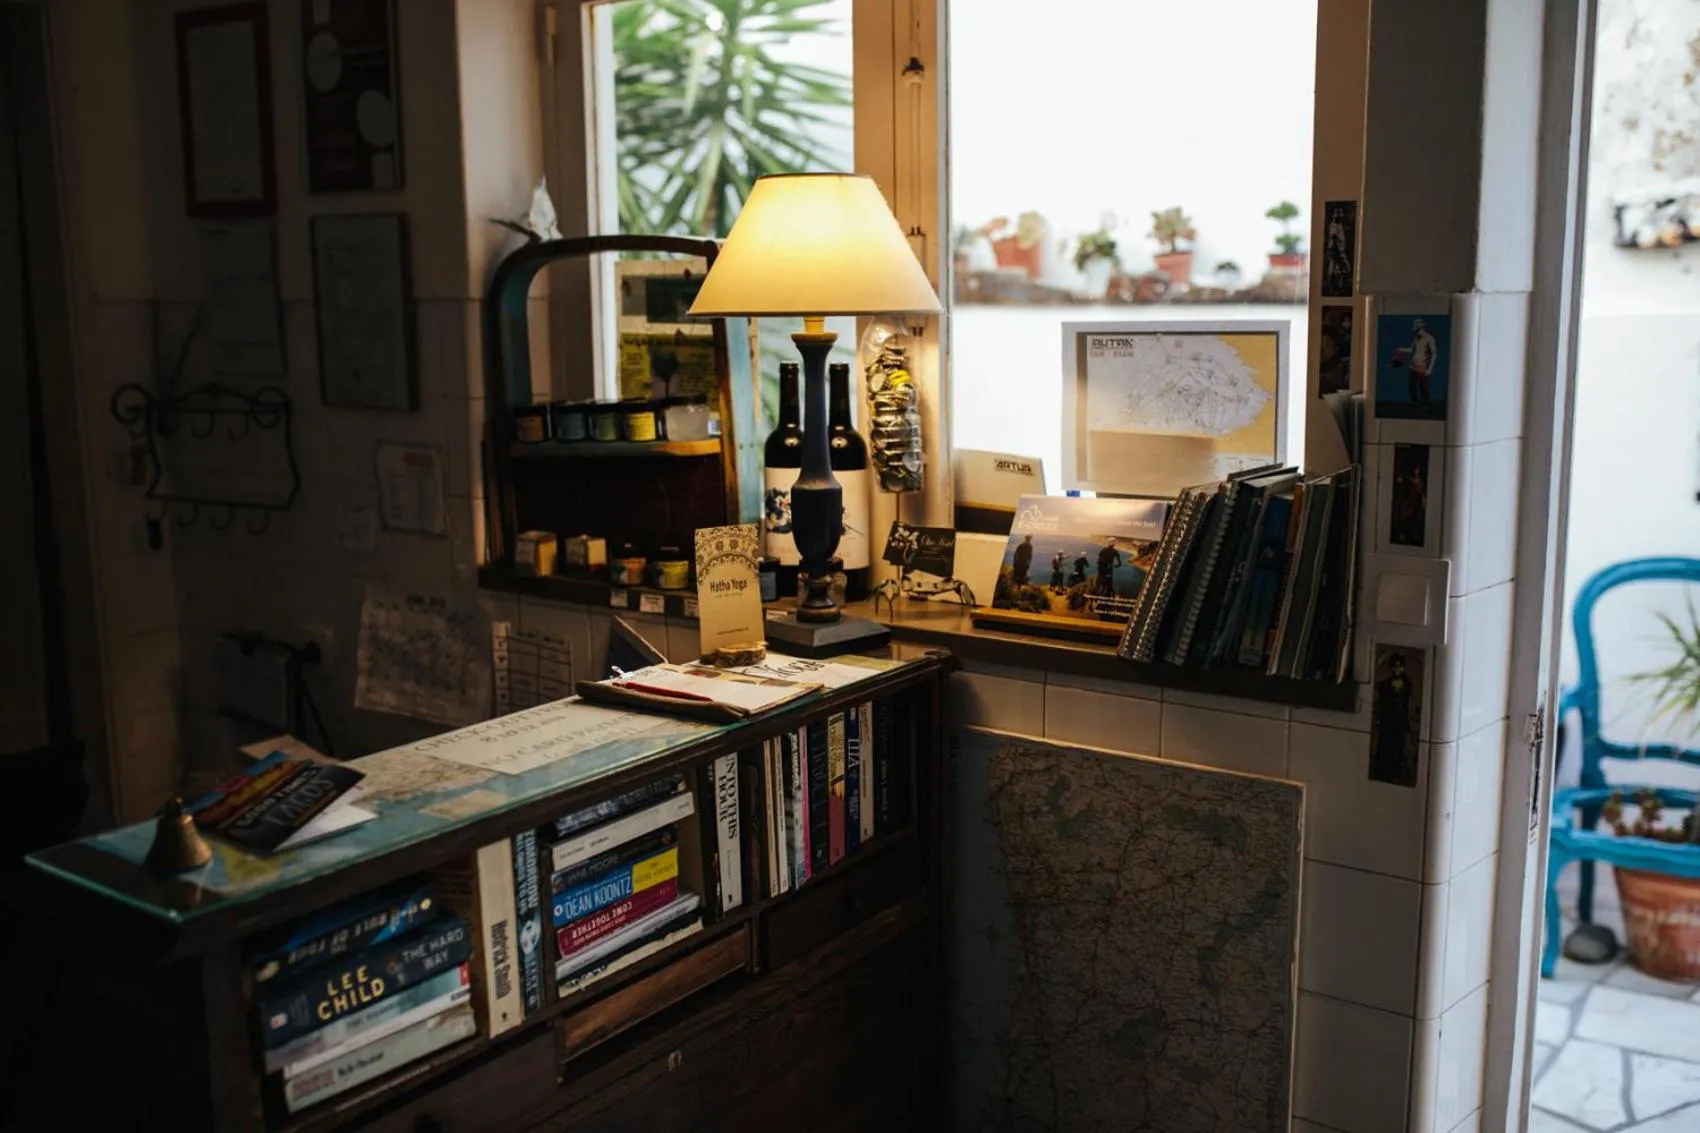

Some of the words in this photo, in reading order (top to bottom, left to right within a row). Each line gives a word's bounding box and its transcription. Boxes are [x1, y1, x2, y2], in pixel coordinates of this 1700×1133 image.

[710, 580, 730, 592] Hatha
[731, 579, 748, 591] Yoga
[718, 776, 728, 823] HOUR
[728, 798, 738, 840] THIS
[524, 829, 540, 909] TOMORROW
[565, 894, 593, 919] DEAN
[594, 875, 632, 907] KOONTZ
[611, 902, 633, 917] COME
[571, 909, 610, 938] TOGETHER
[403, 944, 425, 963] THE
[429, 927, 465, 951] HARD
[422, 950, 449, 970] WAY
[326, 964, 370, 997] LEE
[494, 963, 513, 1000] Smith
[317, 977, 385, 1021] CHILD
